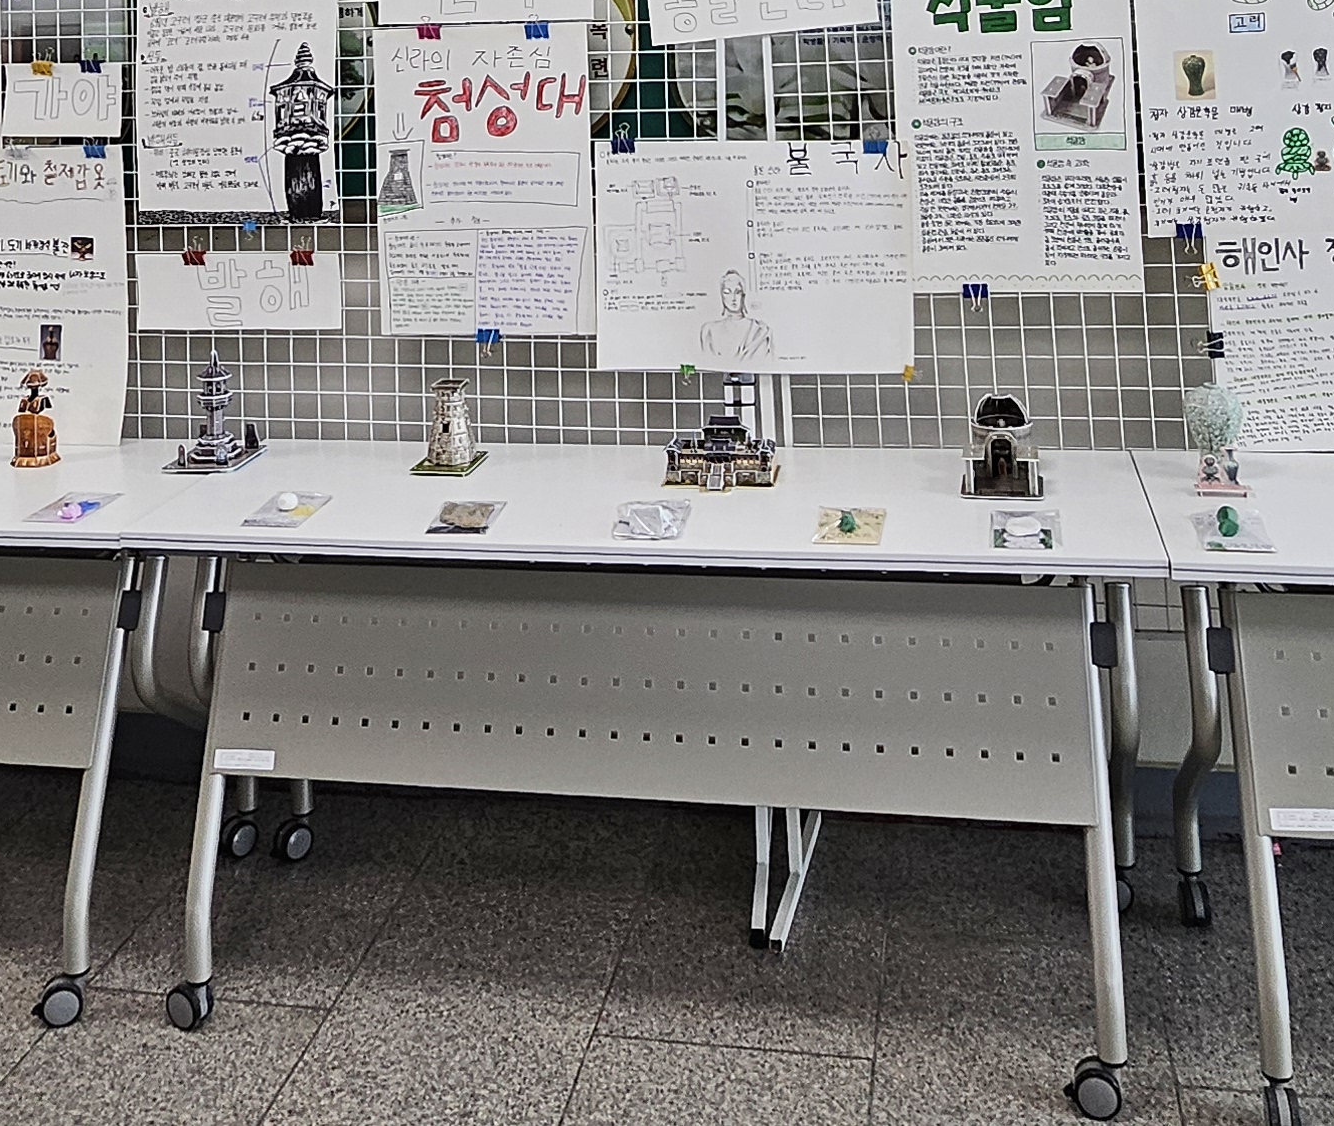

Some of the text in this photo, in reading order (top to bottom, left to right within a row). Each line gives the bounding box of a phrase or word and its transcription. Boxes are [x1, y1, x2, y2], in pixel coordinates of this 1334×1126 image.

[390, 44, 553, 73] 신라의 자존심
[13, 74, 117, 121] 가야
[413, 71, 587, 144] 첨성대
[786, 141, 908, 179] 불국사
[1214, 236, 1310, 276] 해인사
[197, 259, 311, 328] 발해
